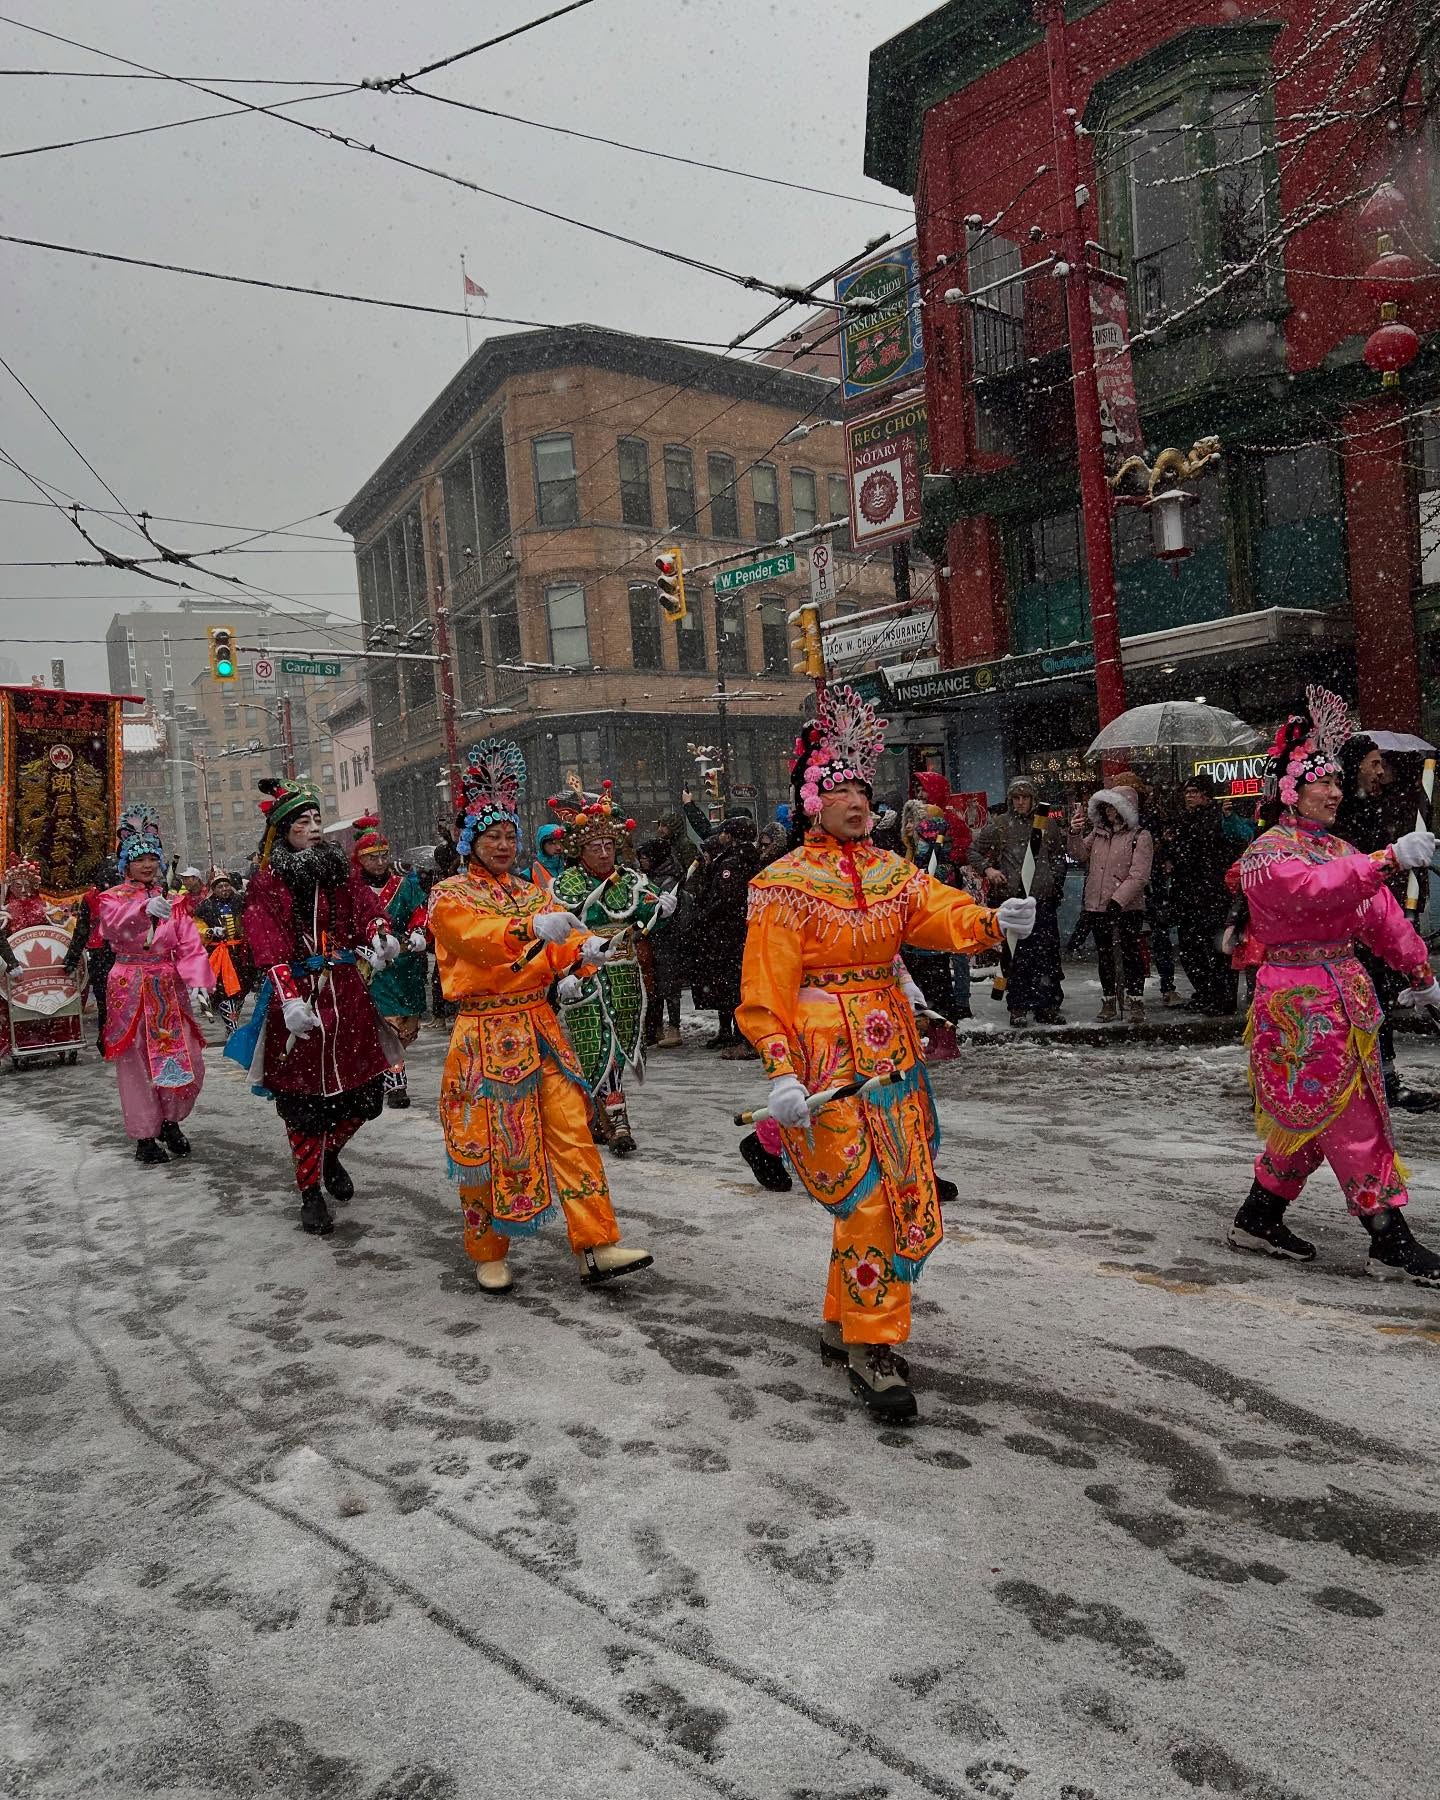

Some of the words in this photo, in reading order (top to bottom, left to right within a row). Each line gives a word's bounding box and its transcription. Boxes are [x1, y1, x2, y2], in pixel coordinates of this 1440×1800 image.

[877, 277, 902, 297] CHOW
[854, 425, 881, 447] REG
[885, 407, 928, 434] CHOW
[855, 442, 897, 467] NOTARY
[720, 573, 732, 588] W
[735, 563, 773, 584] Pender
[777, 558, 790, 573] St
[825, 643, 843, 656] JACK
[857, 633, 878, 649] CHOW
[883, 621, 927, 643] INSURANCE
[285, 661, 321, 674] Carrall
[324, 665, 337, 675] St
[898, 674, 972, 702] INSURANCE
[1197, 760, 1239, 784] CHOW
[1242, 757, 1266, 780] NO
[1231, 778, 1265, 795] 周百
[10, 930, 46, 948] EOCHEW
